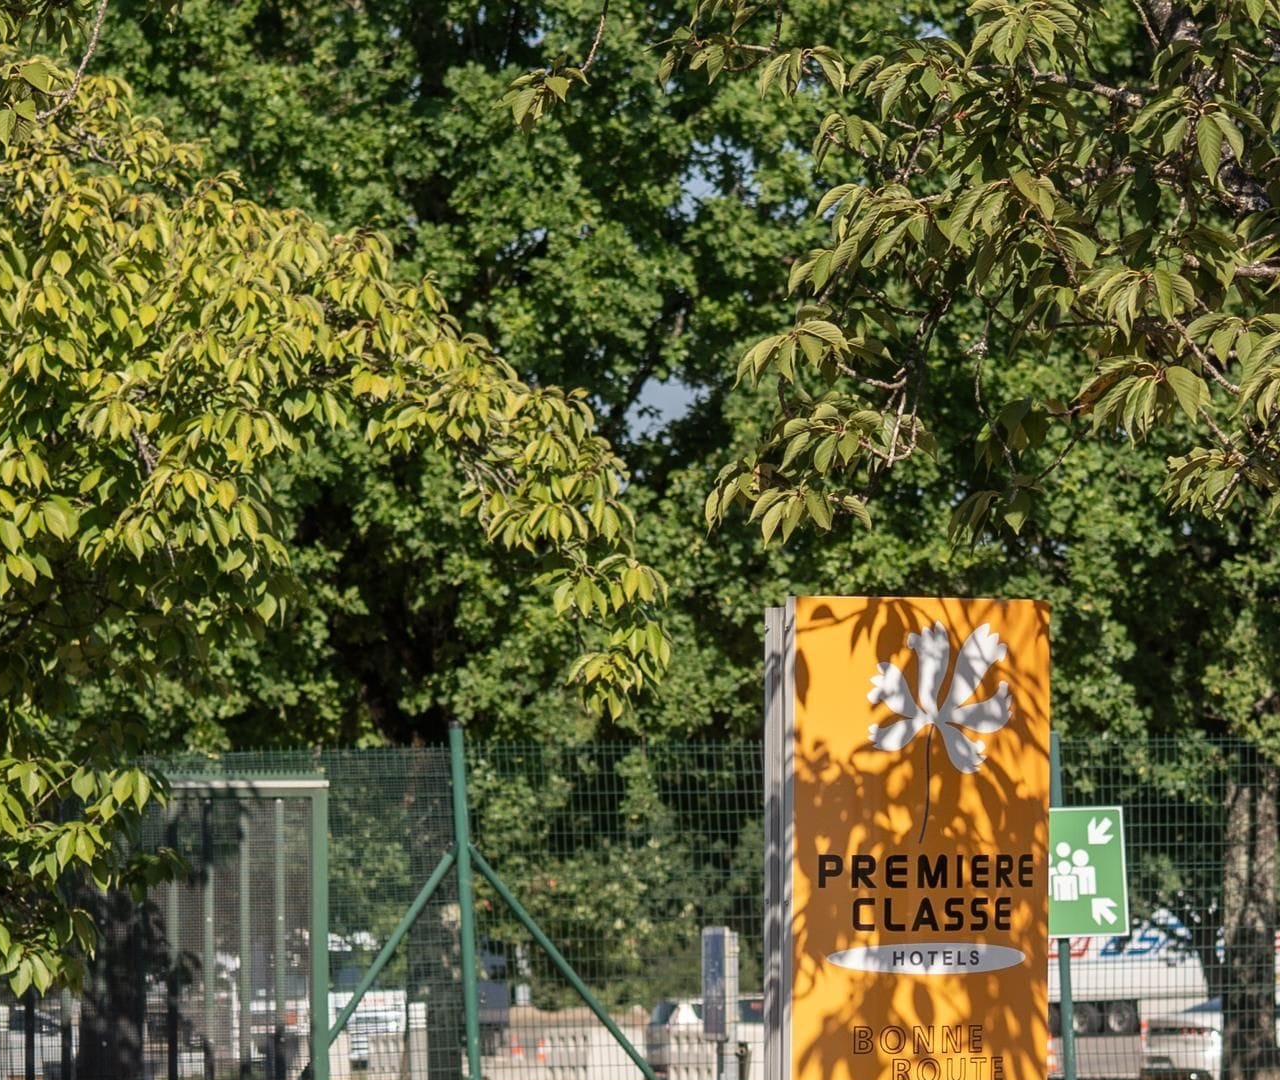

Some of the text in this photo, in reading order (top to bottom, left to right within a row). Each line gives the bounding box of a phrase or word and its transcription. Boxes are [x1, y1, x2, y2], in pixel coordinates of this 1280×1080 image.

[818, 854, 1034, 889] PREMIERE
[852, 897, 1011, 932] CLASSE
[892, 950, 980, 966] HOTELS
[853, 1024, 983, 1055] BONNE
